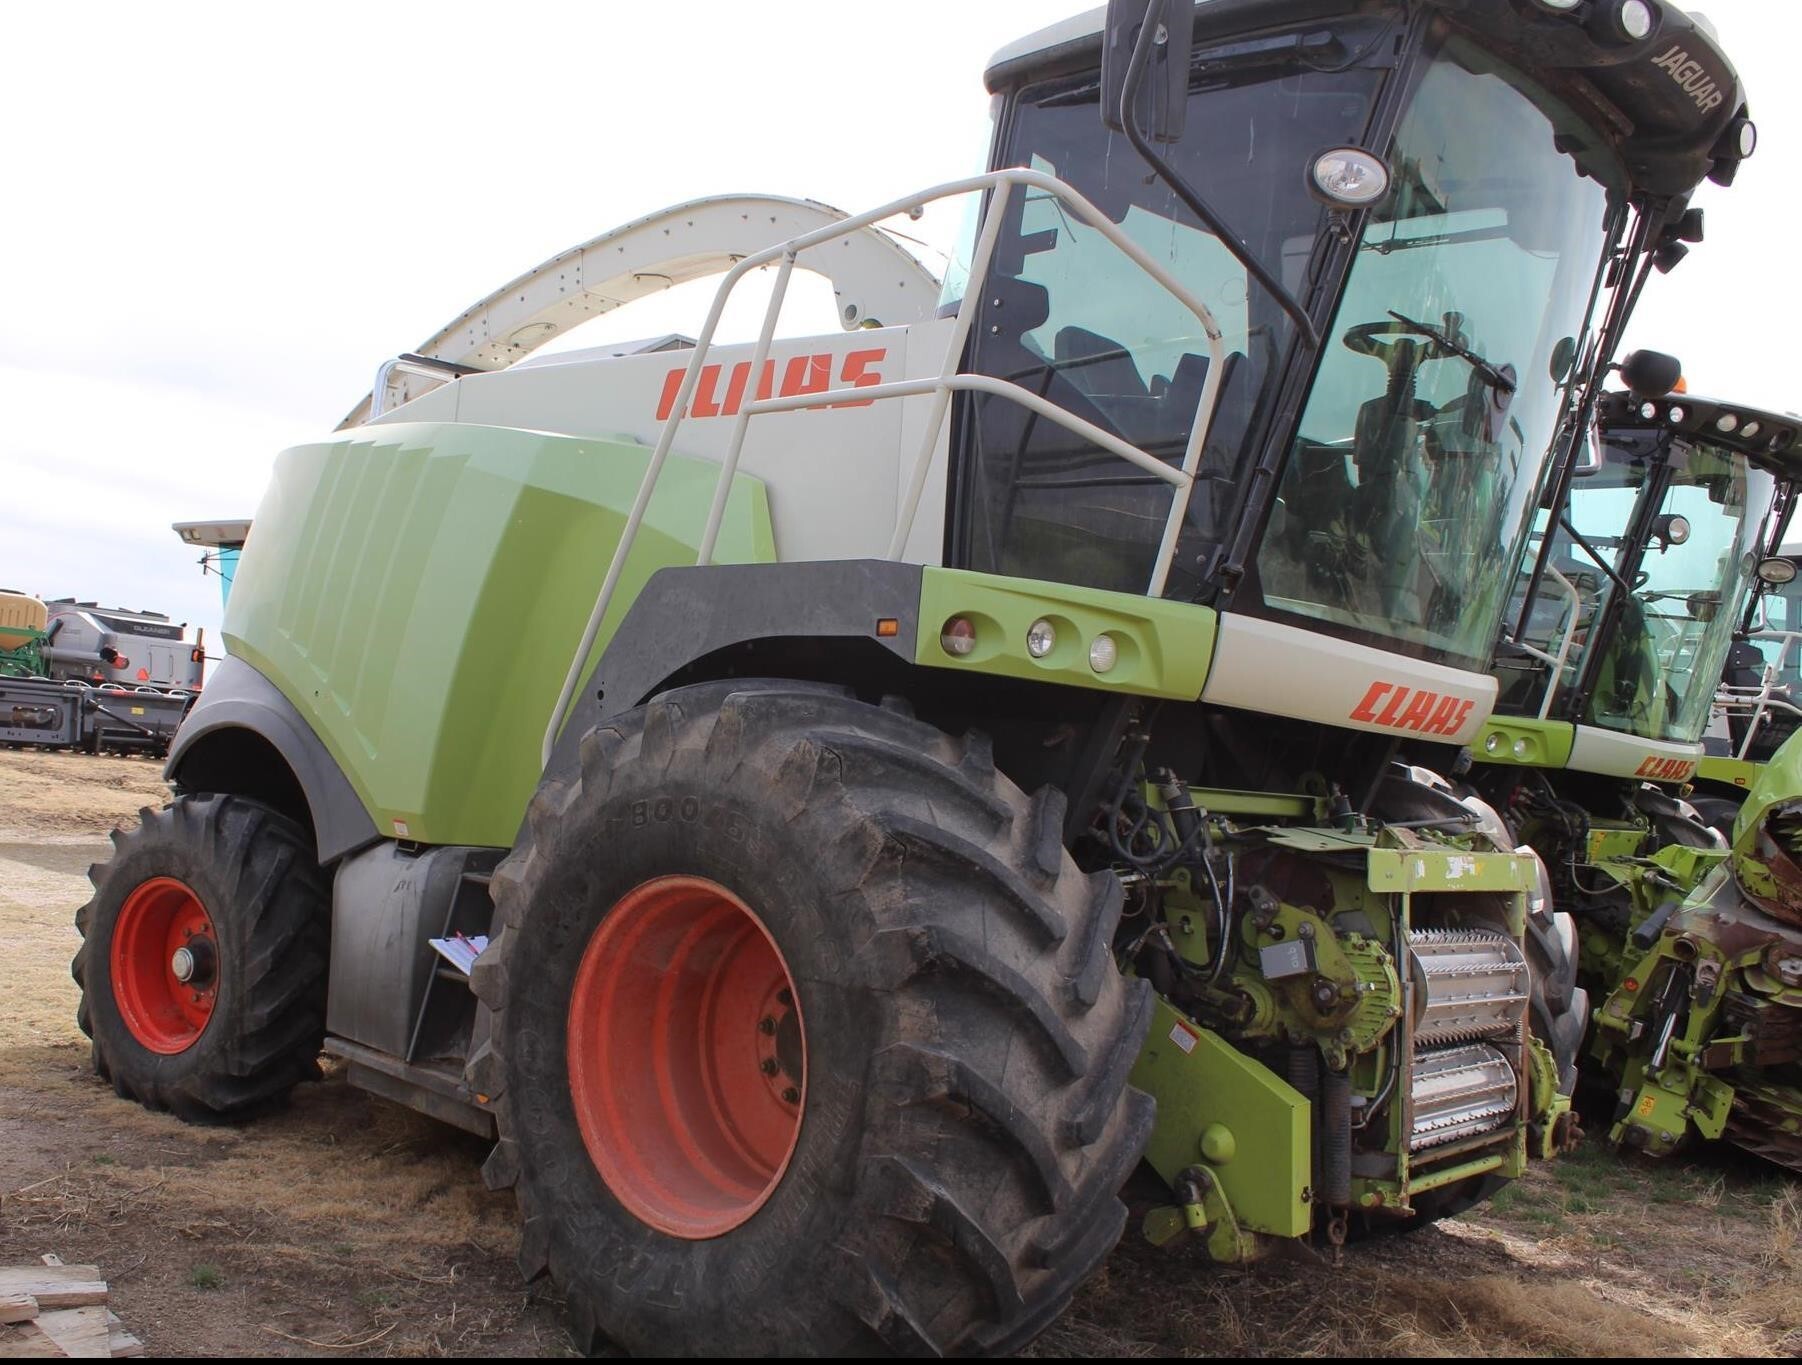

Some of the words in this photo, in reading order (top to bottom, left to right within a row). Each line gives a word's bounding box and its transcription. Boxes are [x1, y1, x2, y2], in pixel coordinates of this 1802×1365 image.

[1650, 45, 1722, 114] JAGUAR
[1350, 681, 1475, 736] CLAAS
[1634, 756, 1696, 779] CLAAS
